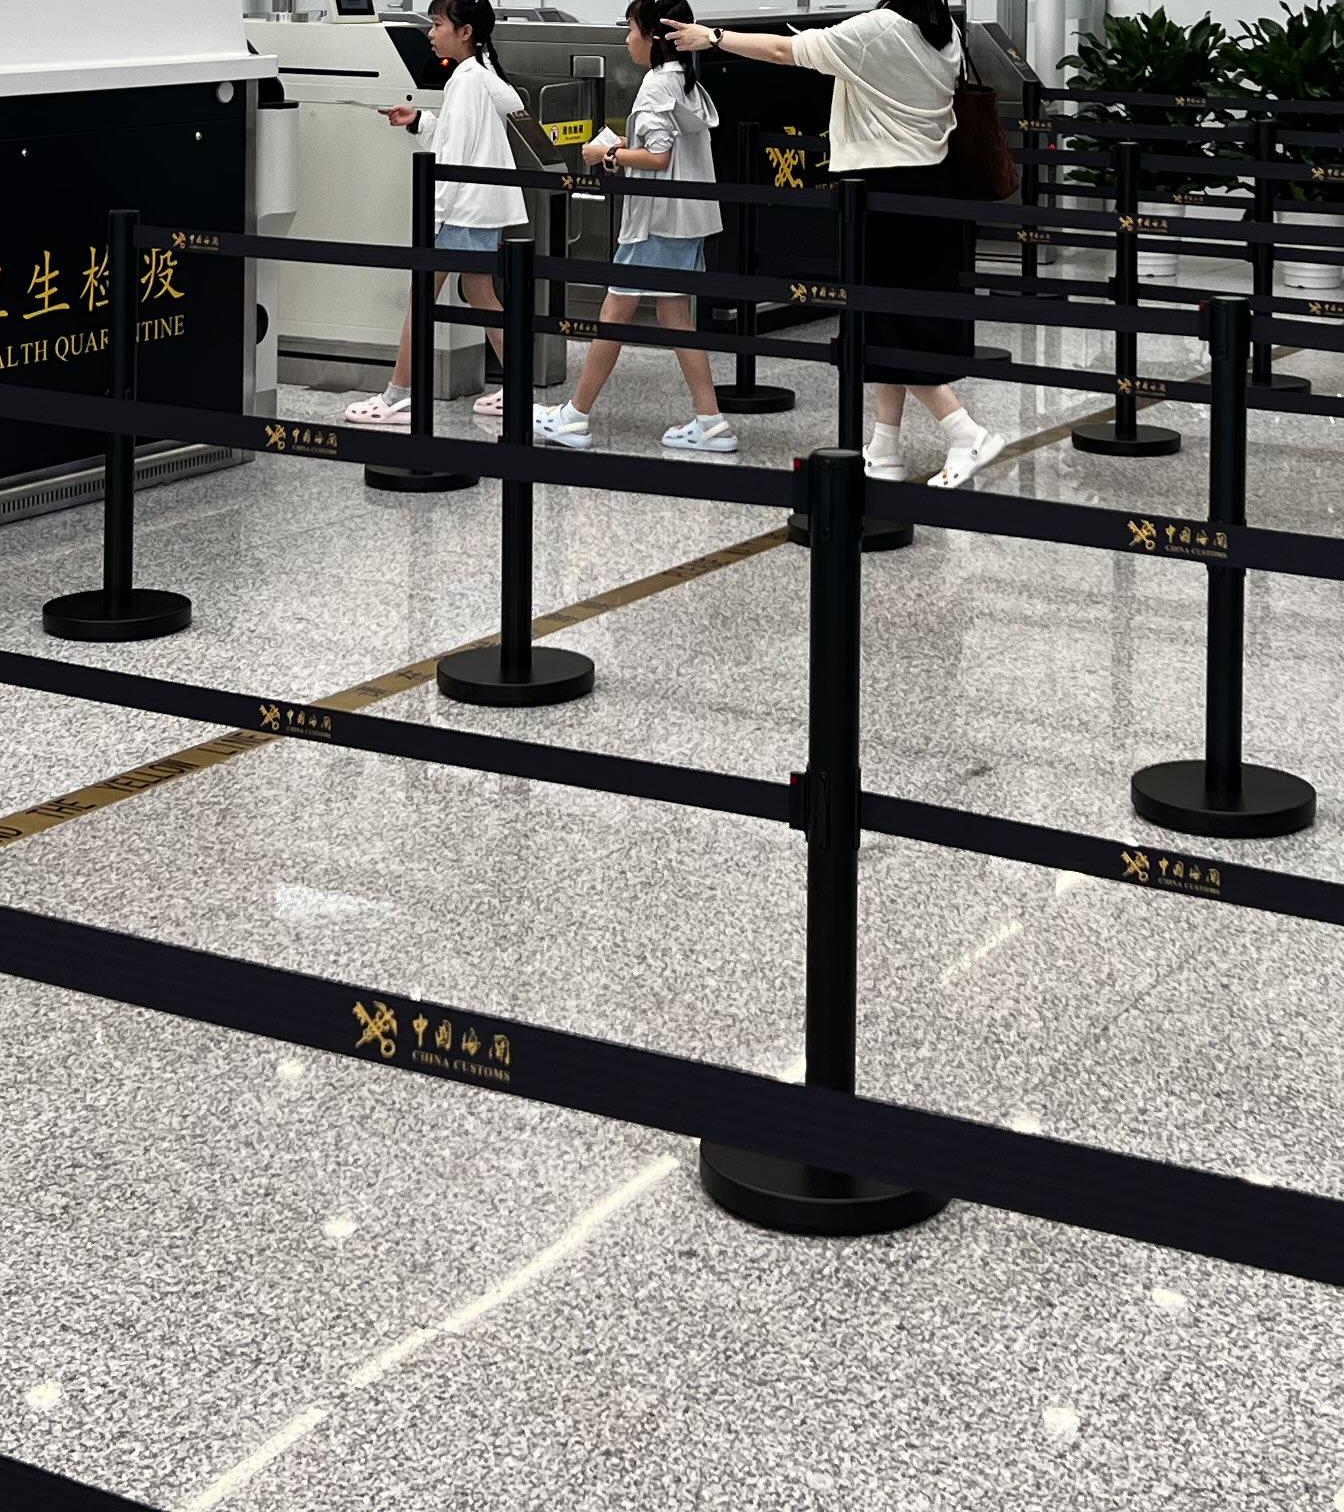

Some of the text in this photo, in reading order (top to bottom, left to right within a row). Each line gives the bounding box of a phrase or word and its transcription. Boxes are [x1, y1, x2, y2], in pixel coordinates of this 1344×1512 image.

[26, 797, 97, 820] THE
[103, 757, 201, 793] YELLOW
[210, 729, 272, 755] LINE
